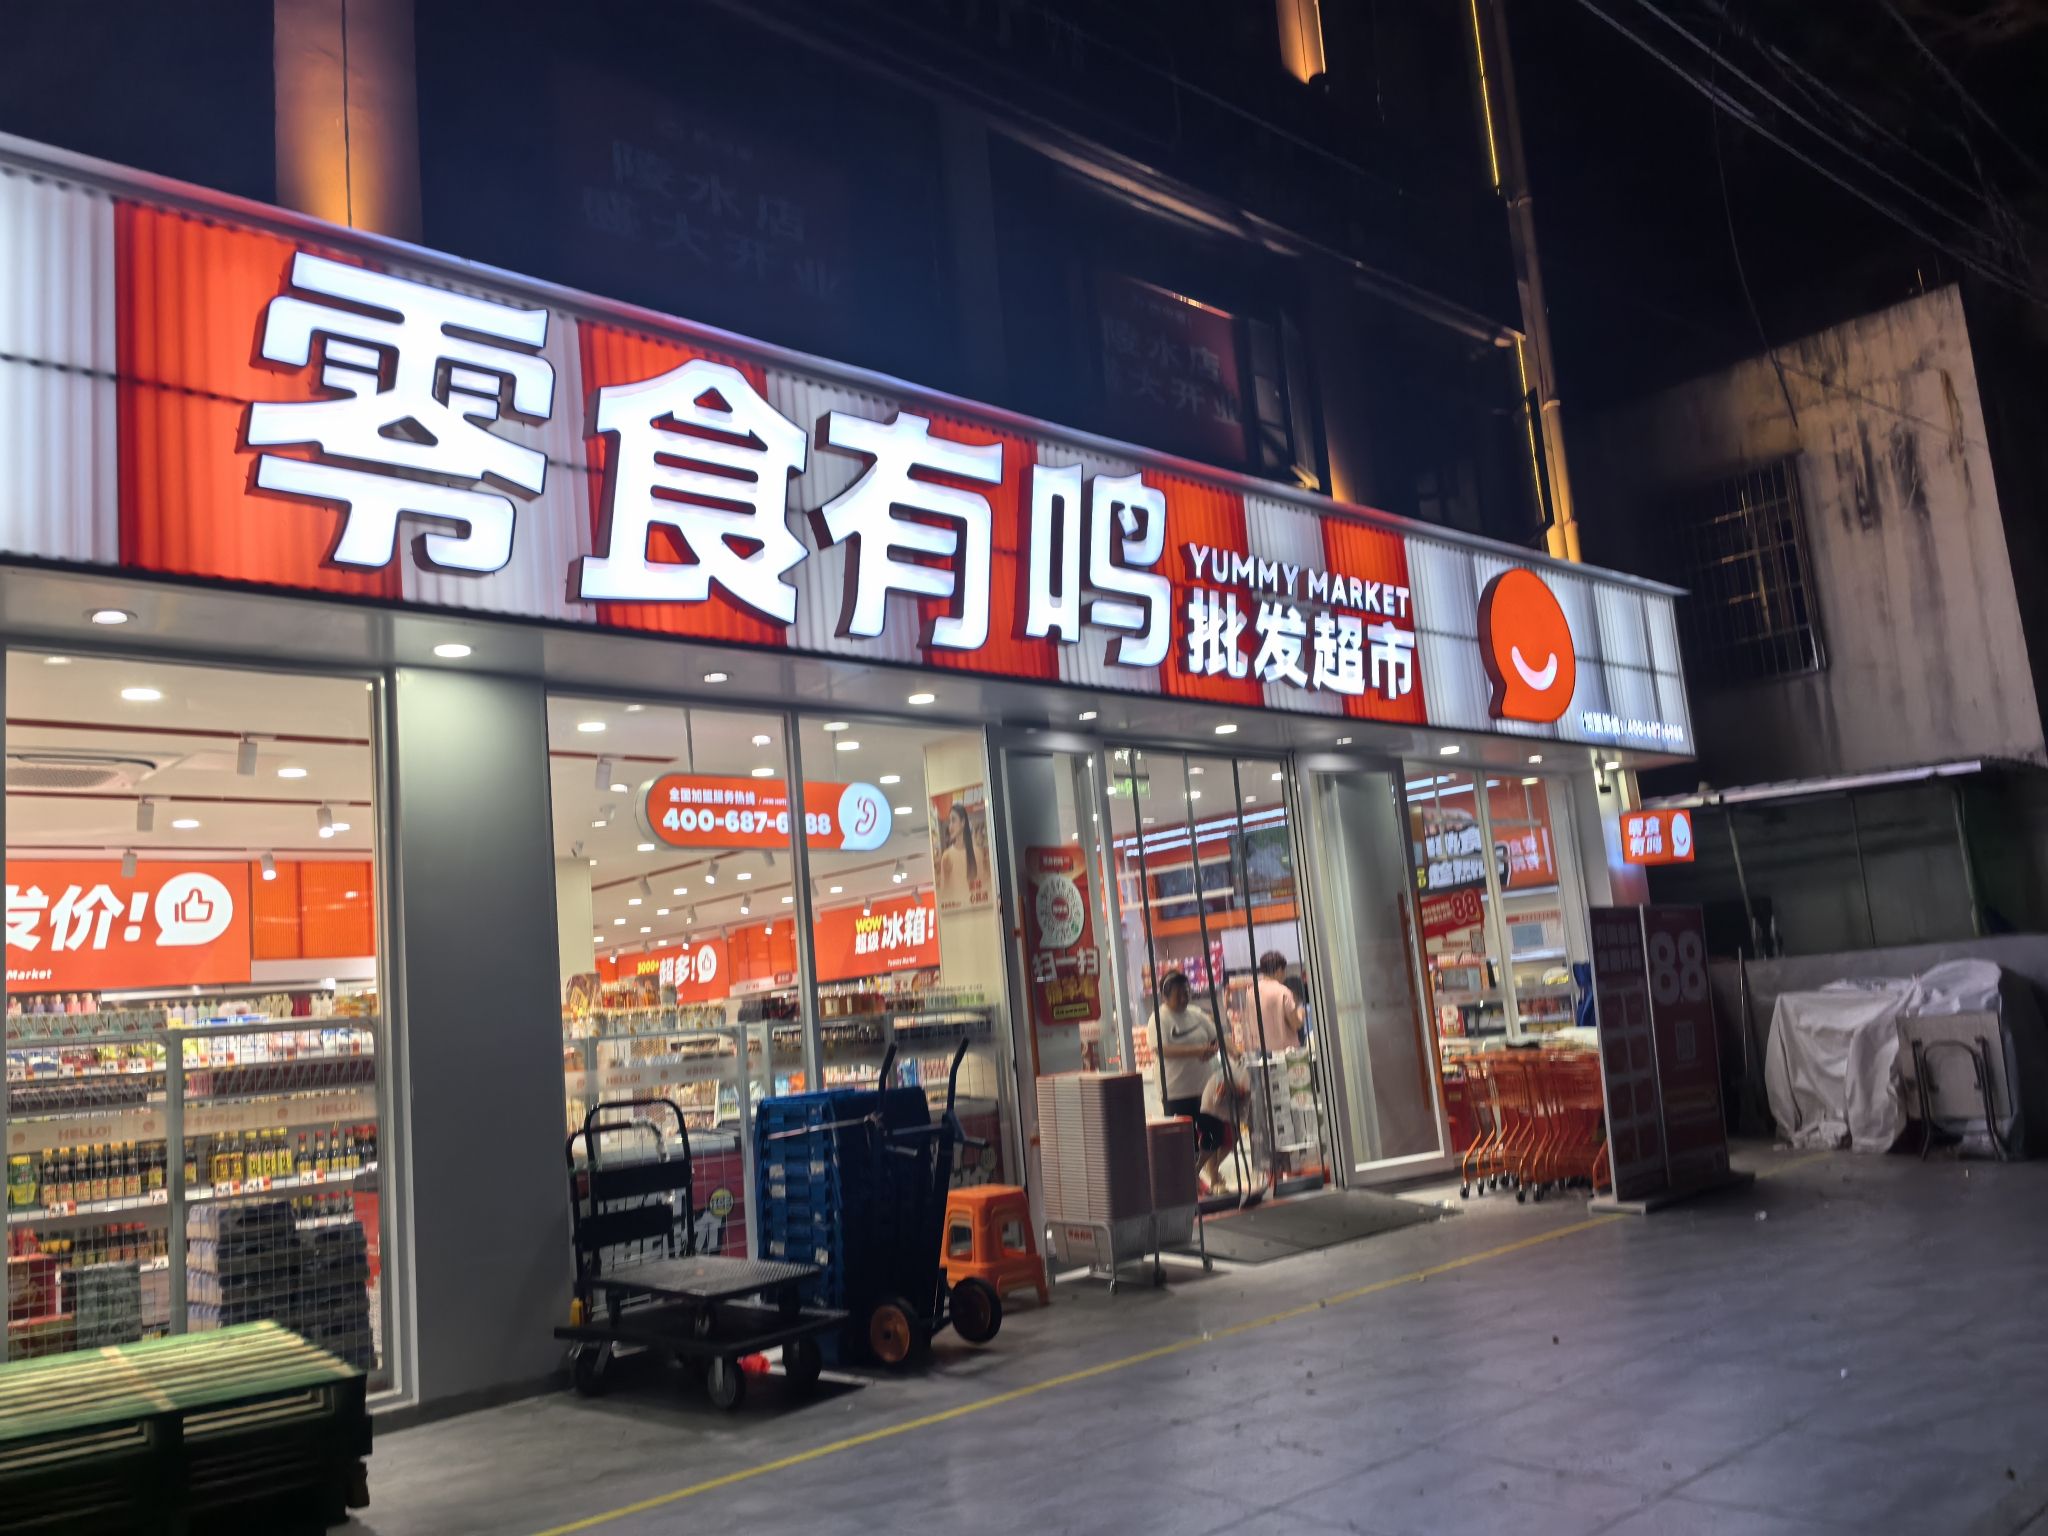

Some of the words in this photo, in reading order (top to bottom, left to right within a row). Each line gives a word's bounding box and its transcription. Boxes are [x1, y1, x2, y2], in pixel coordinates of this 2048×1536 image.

[246, 252, 1172, 668] 零食有鸣
[1188, 541, 1300, 596] YUMMY
[1308, 567, 1410, 618] MARKET
[1187, 586, 1415, 700] 批发超市
[662, 808, 832, 836] 400-687-688
[855, 914, 883, 934] WOW
[880, 906, 935, 951] 冰箱!
[1032, 946, 1100, 981] 扫一扫
[1649, 929, 1708, 1006] 88
